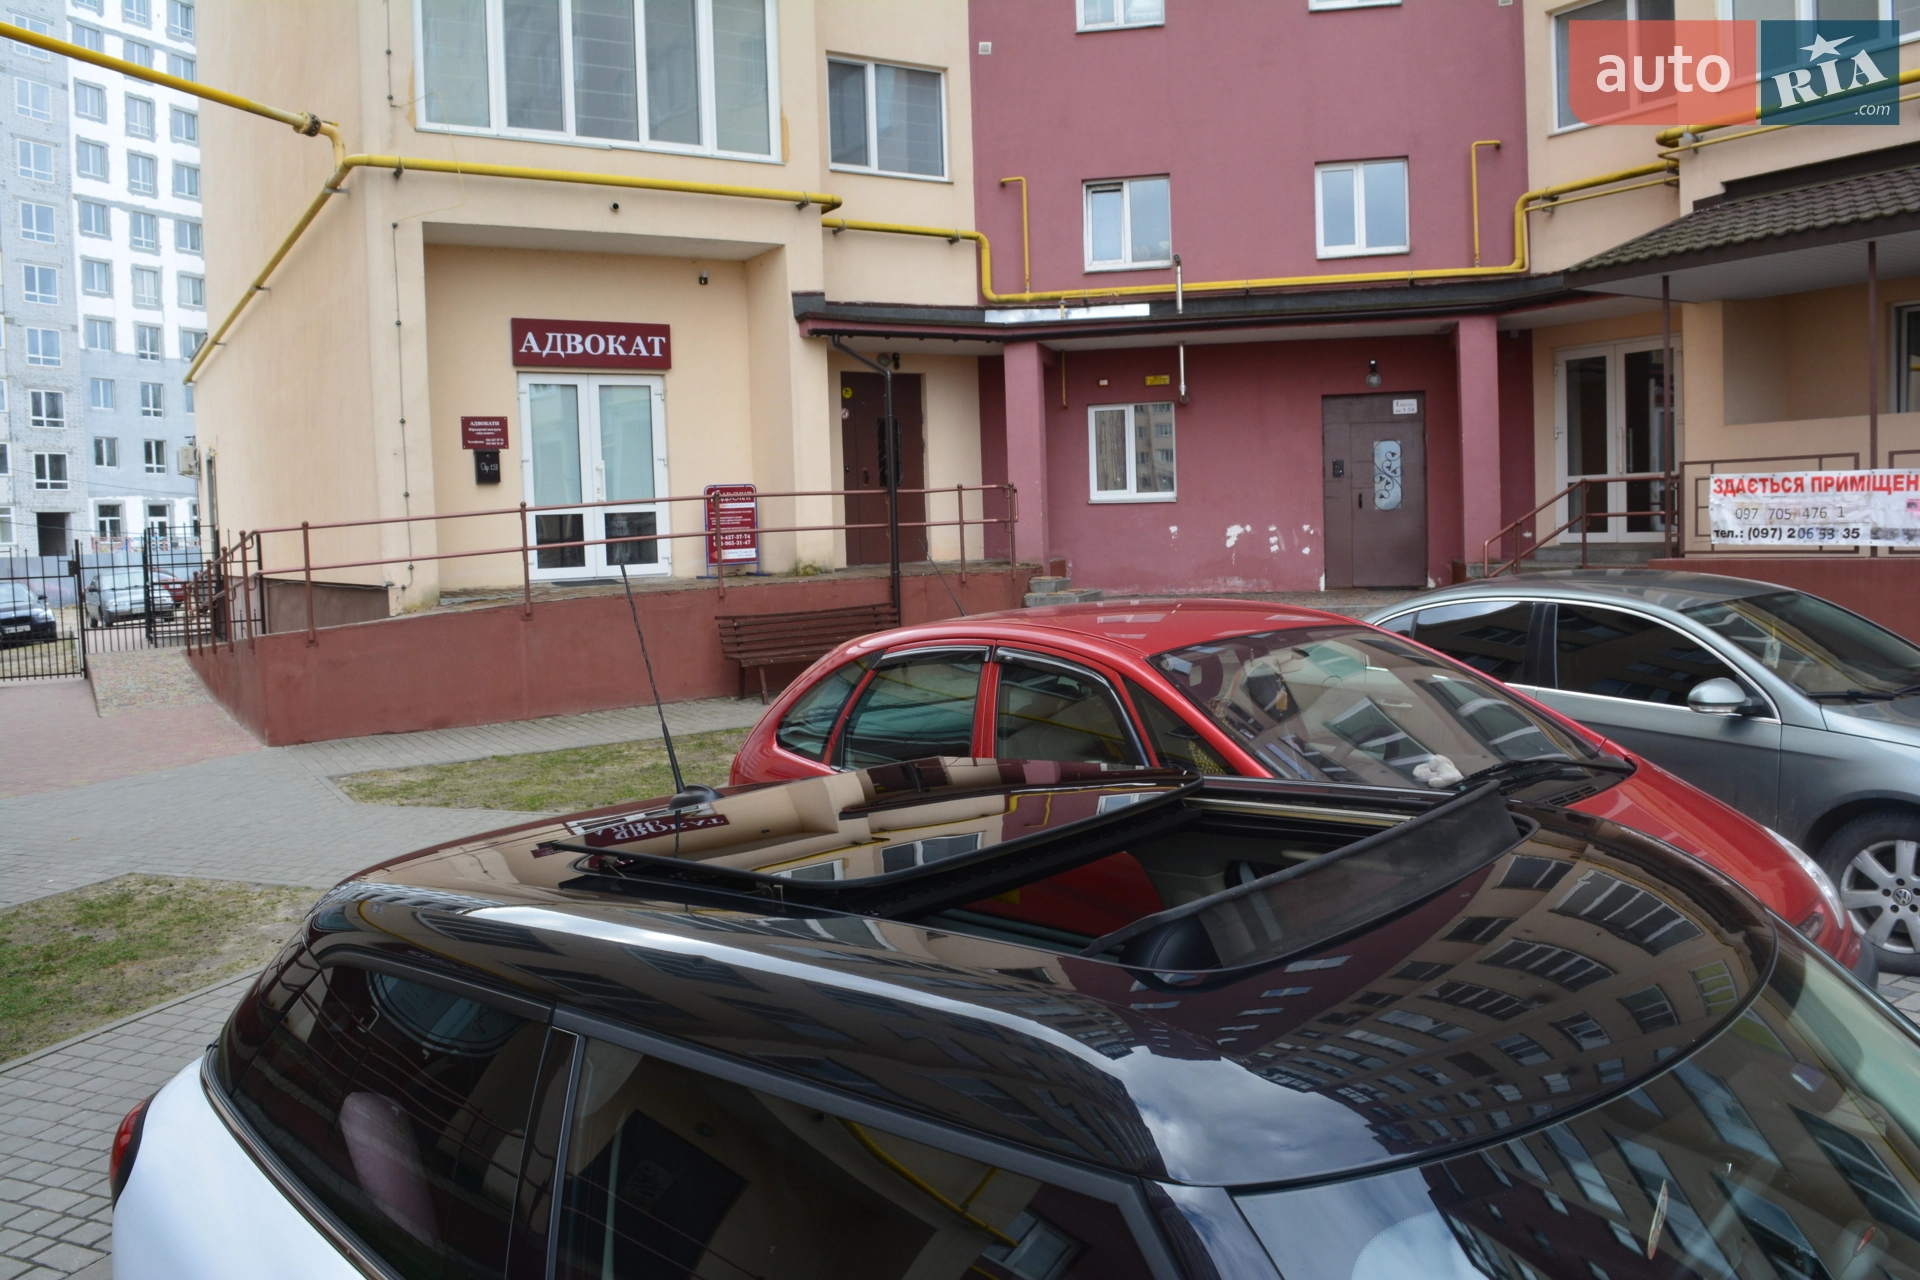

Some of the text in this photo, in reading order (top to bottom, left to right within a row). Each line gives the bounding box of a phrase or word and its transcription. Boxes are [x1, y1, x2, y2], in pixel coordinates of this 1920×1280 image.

[519, 331, 666, 358] АДВОКАТ
[1713, 474, 1919, 497] ЗДАЄТЬСЯ ПРИМІЩЕН
[1735, 506, 1845, 520] 097 705 476 1
[1714, 529, 1744, 539] тел.:
[1748, 527, 1782, 541] (097)
[1842, 528, 1860, 539] 35
